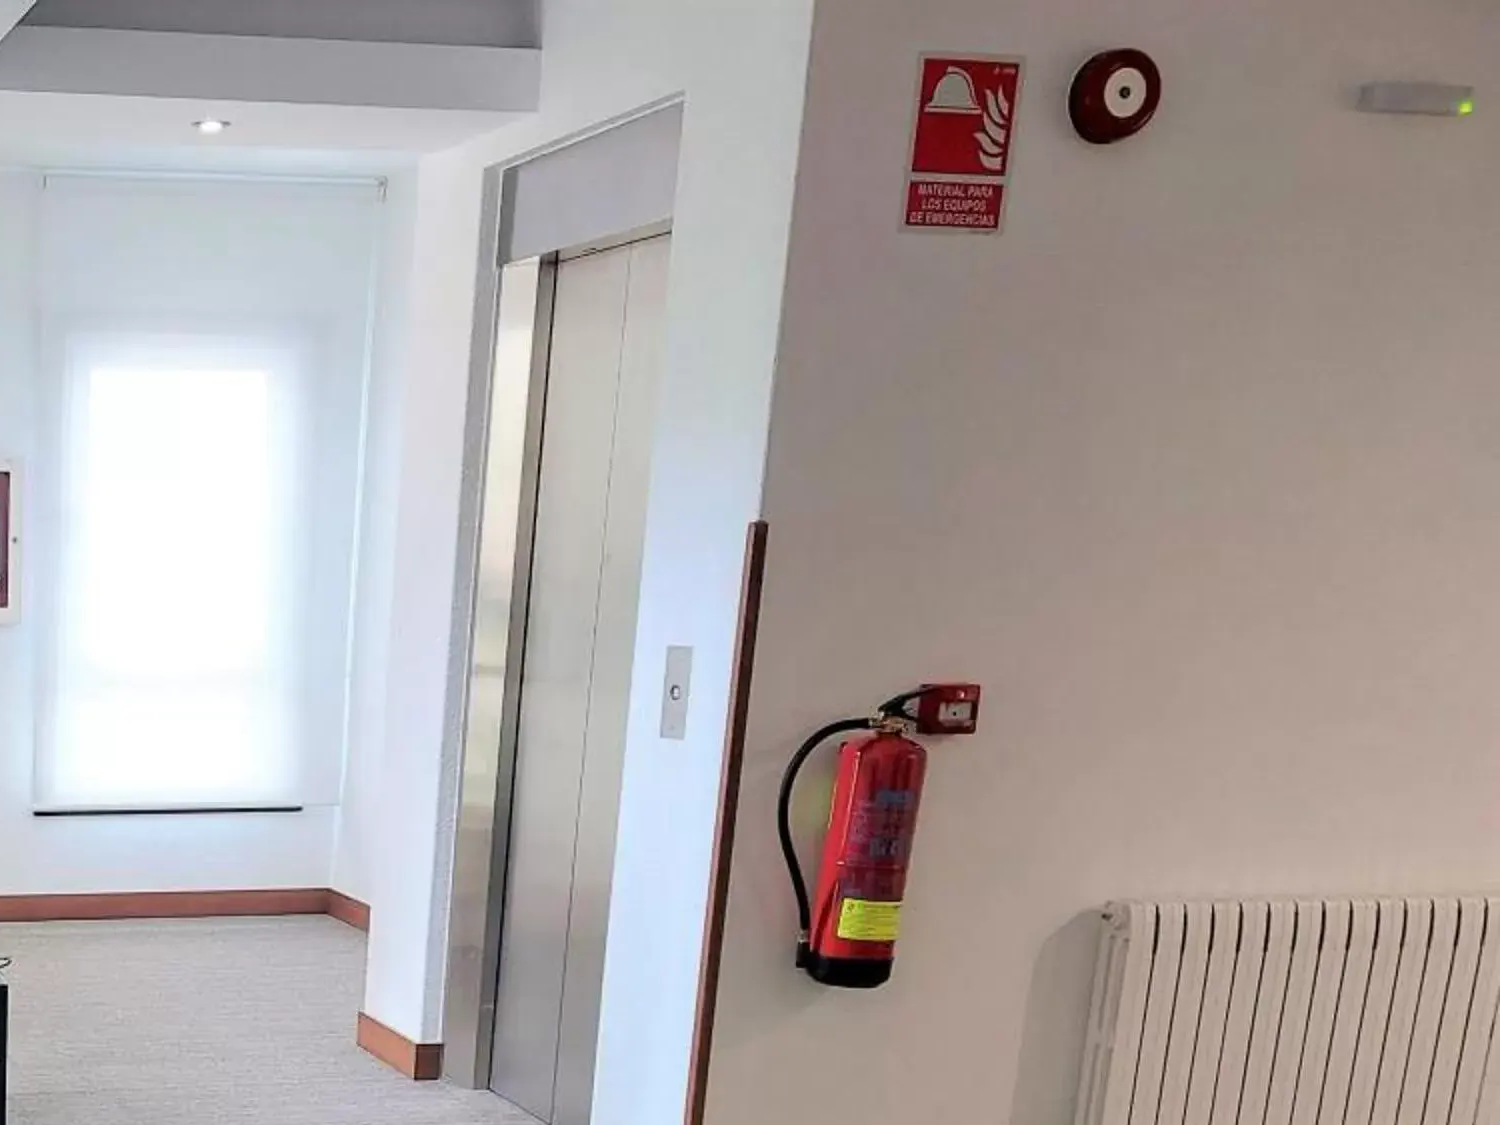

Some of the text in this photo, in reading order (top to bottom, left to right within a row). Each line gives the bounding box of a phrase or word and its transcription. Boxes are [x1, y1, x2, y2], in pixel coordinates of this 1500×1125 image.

[917, 184, 993, 198] MATERIAL PARA
[921, 198, 986, 212] LOS EQUIPOS
[909, 211, 995, 225] DE EMERGENCIAS
